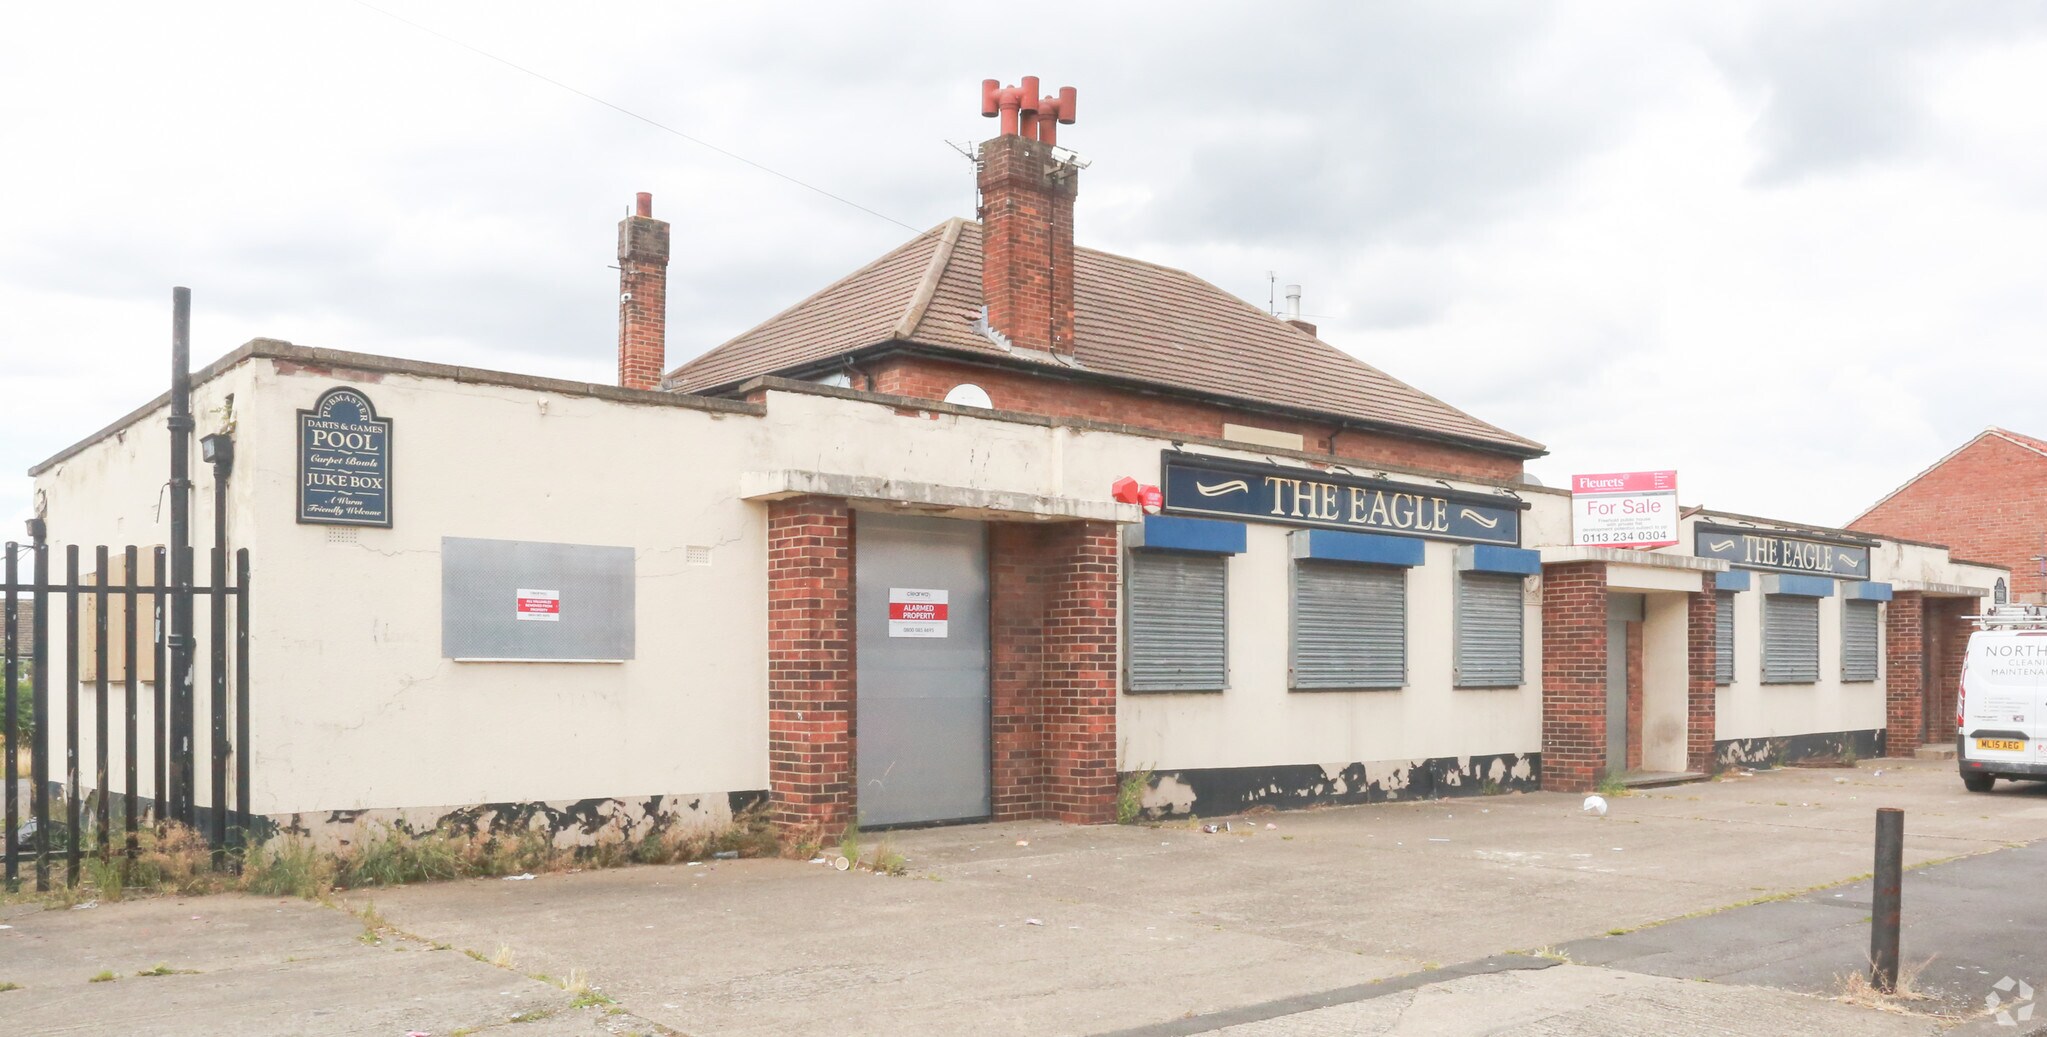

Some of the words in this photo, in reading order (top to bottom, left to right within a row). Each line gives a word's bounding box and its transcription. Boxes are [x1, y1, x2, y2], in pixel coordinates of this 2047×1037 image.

[323, 395, 368, 421] PUBMASTER
[308, 420, 339, 429] DARTS
[350, 424, 383, 433] GAMES
[312, 429, 378, 451] POOL
[311, 454, 342, 466] Carpet
[346, 457, 378, 467] Bowls
[306, 473, 347, 487] JUKE
[351, 476, 383, 489] BOX
[1580, 478, 1624, 488] Fleurets
[307, 505, 344, 516] Friendly
[346, 507, 381, 516] Welcome
[1265, 476, 1339, 521] THE
[1348, 486, 1449, 533] EAGLE
[1588, 501, 1616, 515] For
[1623, 499, 1661, 514] Sale
[1583, 533, 1609, 542] 0113
[1613, 532, 1634, 542] 234
[1638, 531, 1667, 540] 0304
[1742, 535, 1779, 566] THE
[1781, 540, 1833, 571] EAGLE
[2002, 741, 2019, 750] AEG
